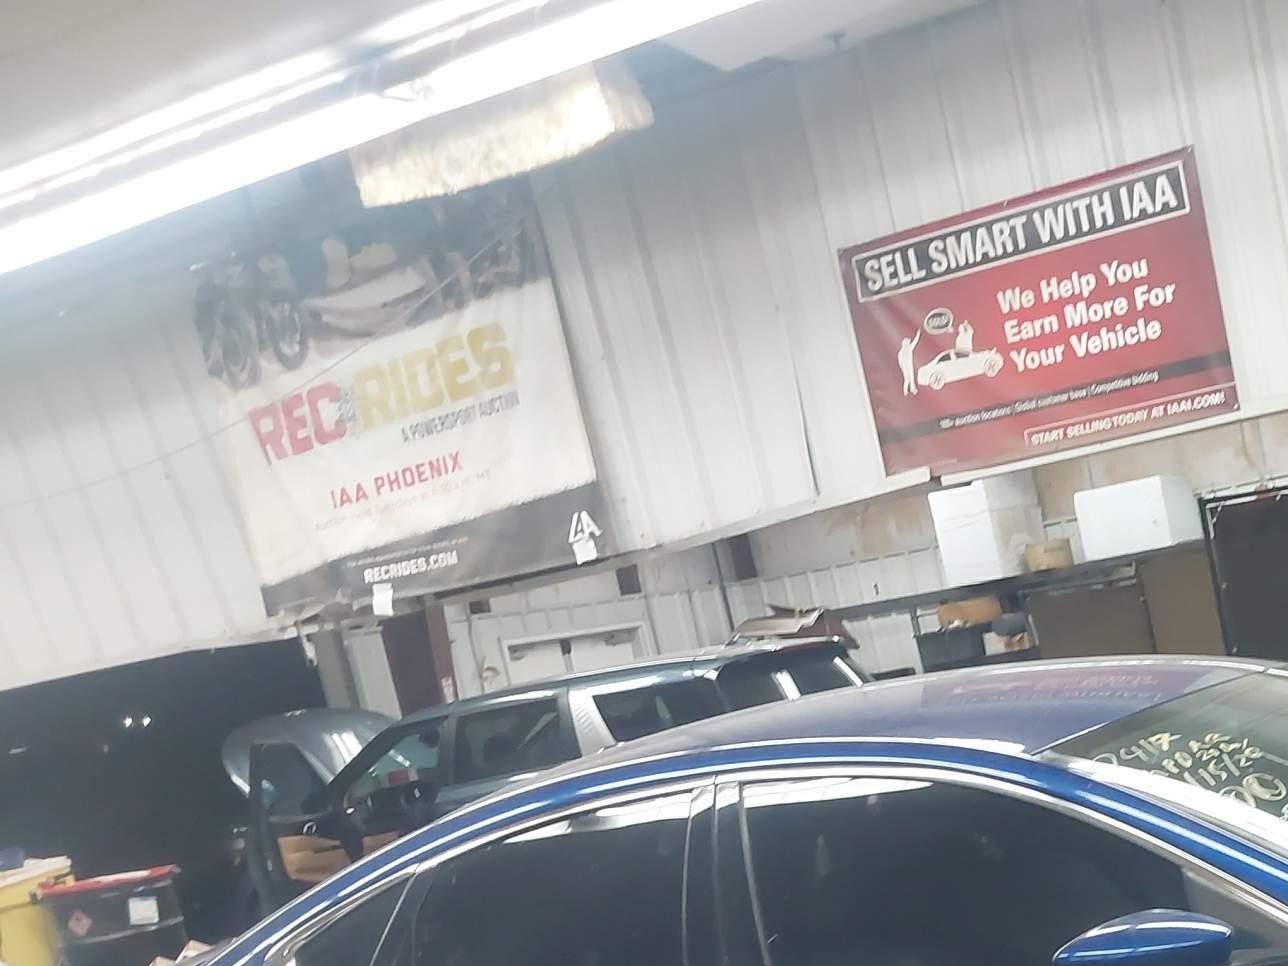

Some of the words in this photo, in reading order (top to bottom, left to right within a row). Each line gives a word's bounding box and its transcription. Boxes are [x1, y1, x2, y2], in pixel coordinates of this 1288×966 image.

[864, 248, 927, 292] SELL
[928, 214, 1028, 275] SMART
[1032, 191, 1116, 244] WITH
[1119, 173, 1179, 221] IAA
[996, 286, 1035, 314] We
[1039, 271, 1097, 303] Help
[1100, 258, 1149, 287] You
[1003, 314, 1060, 344] Earn
[1063, 296, 1129, 329] More
[1133, 282, 1176, 312] For
[1009, 344, 1065, 373] Your
[1069, 317, 1162, 358] Vehicle
[249, 381, 348, 466] REC
[351, 322, 516, 434] RIDES
[1031, 427, 1065, 446] START
[1066, 417, 1111, 439] SELLING
[1111, 407, 1149, 429] TODAY
[1151, 404, 1165, 419] AT
[330, 483, 369, 509] IAA
[374, 450, 464, 496] PHOENIX
[363, 549, 460, 585] RECRIDES.COM
